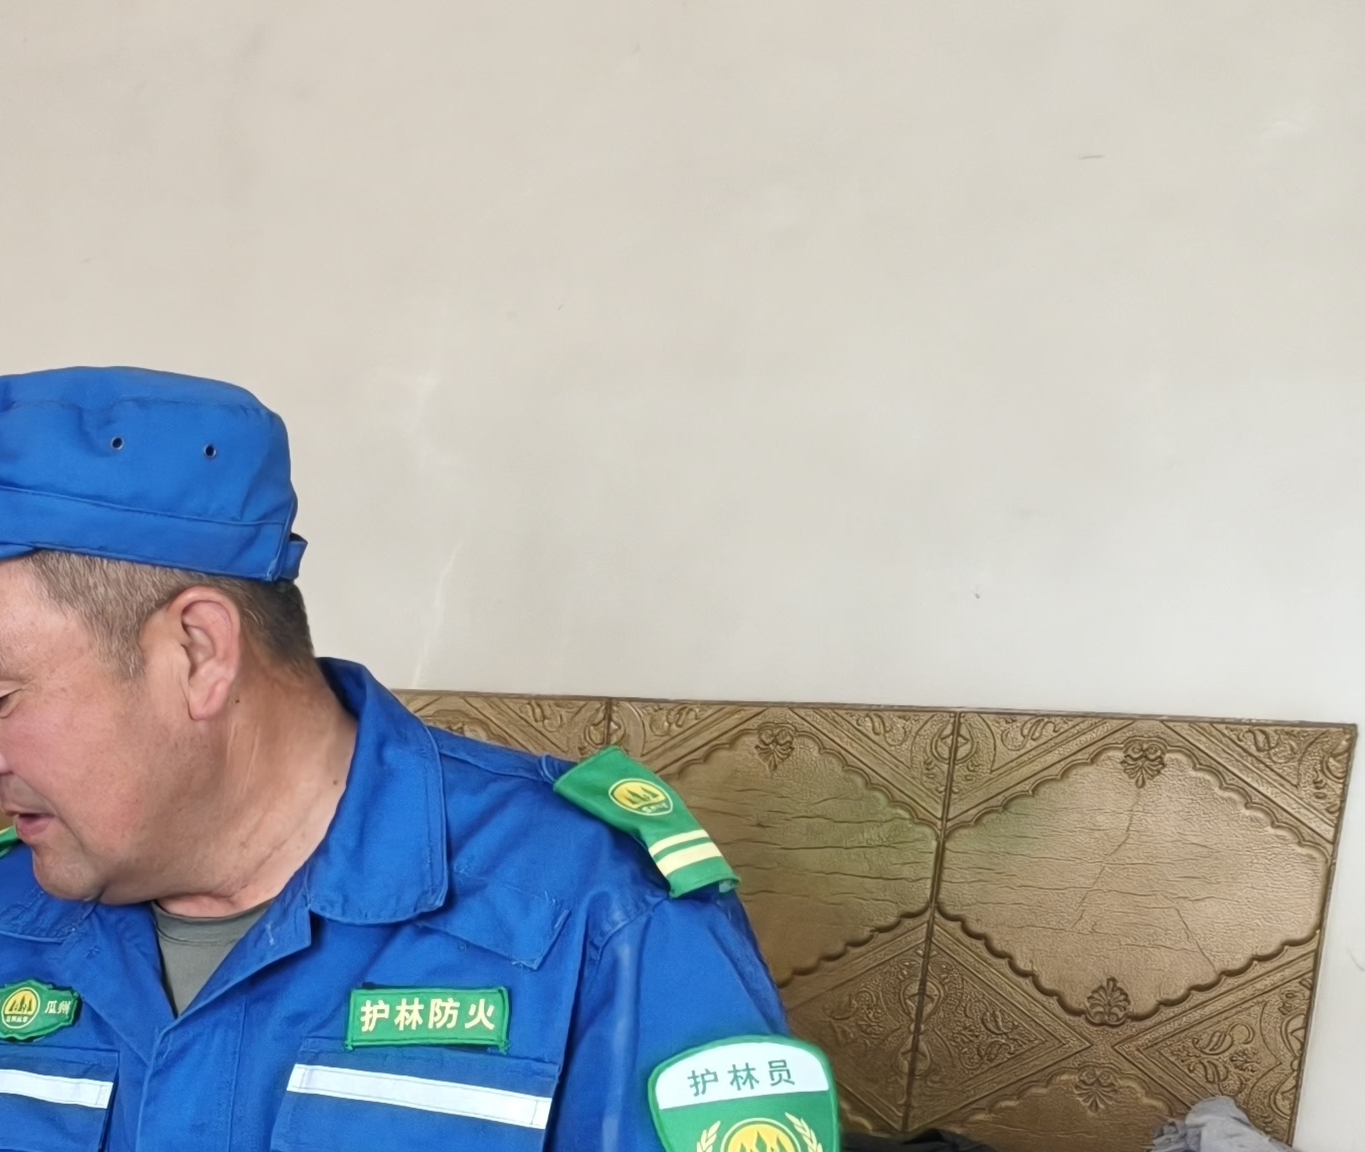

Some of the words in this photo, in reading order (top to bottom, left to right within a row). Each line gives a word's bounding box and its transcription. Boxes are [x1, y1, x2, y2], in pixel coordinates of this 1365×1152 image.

[360, 998, 495, 1033] 护林防火
[687, 1059, 796, 1097] 护林员
